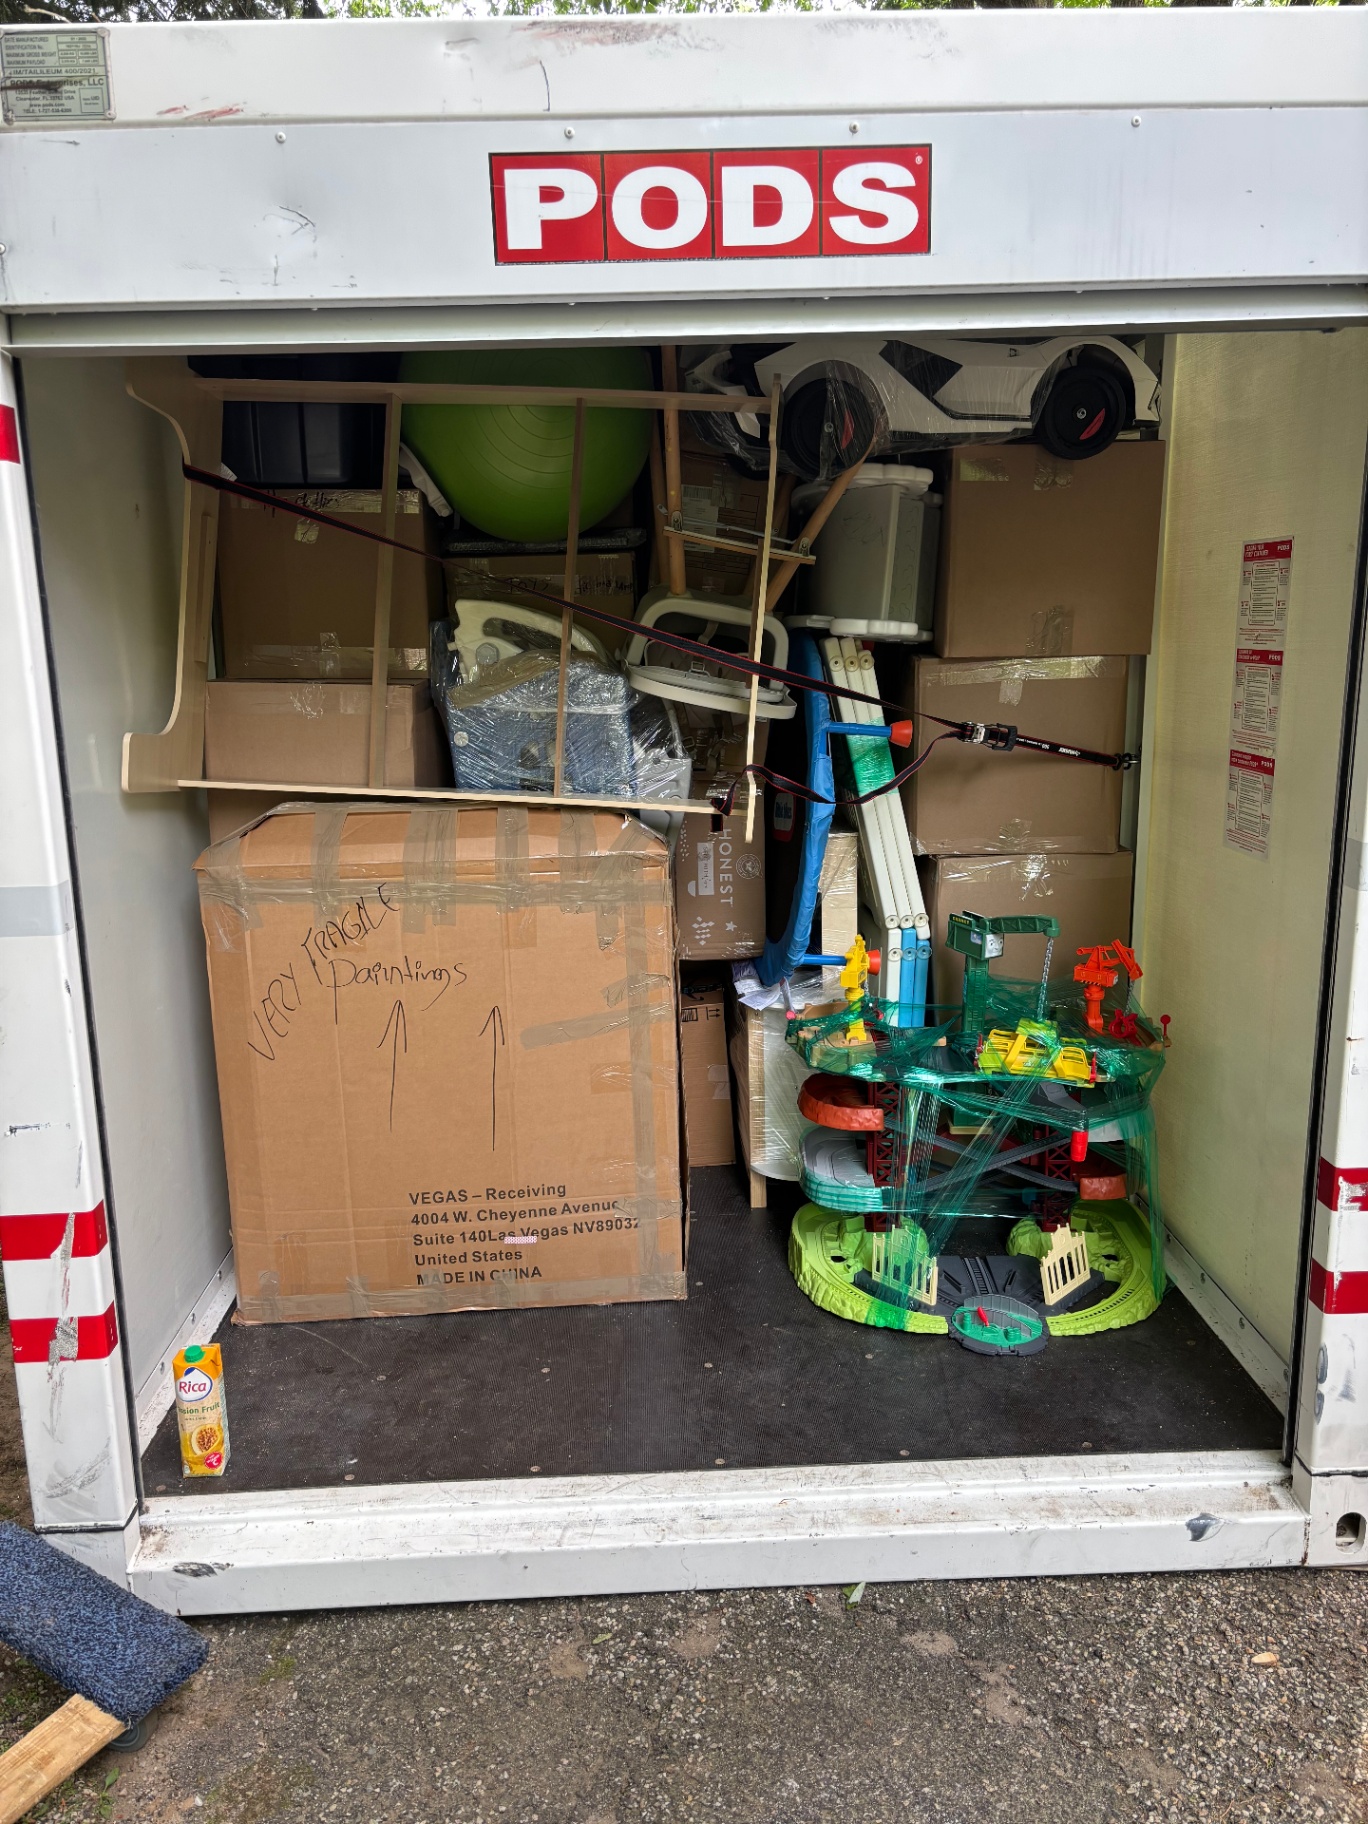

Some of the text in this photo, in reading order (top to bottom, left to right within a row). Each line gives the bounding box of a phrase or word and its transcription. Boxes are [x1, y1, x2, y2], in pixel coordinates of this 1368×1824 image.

[504, 162, 919, 250] PODS
[719, 828, 733, 907] HONEST
[248, 882, 400, 1061] VERY FRAGILE
[326, 956, 468, 1025] Paintings
[409, 1189, 468, 1206] VEGAS
[486, 1184, 566, 1201] Receiving
[411, 1212, 449, 1226] 4004
[453, 1210, 472, 1223] W.
[477, 1205, 558, 1222] Cheyenne
[413, 1233, 454, 1246] Suite
[520, 1224, 569, 1240] Vegas
[414, 1248, 523, 1266] United States
[416, 1272, 465, 1286] MADE
[469, 1270, 485, 1282] IN
[179, 1381, 207, 1394] Rica
[202, 1402, 220, 1413] Fruit
